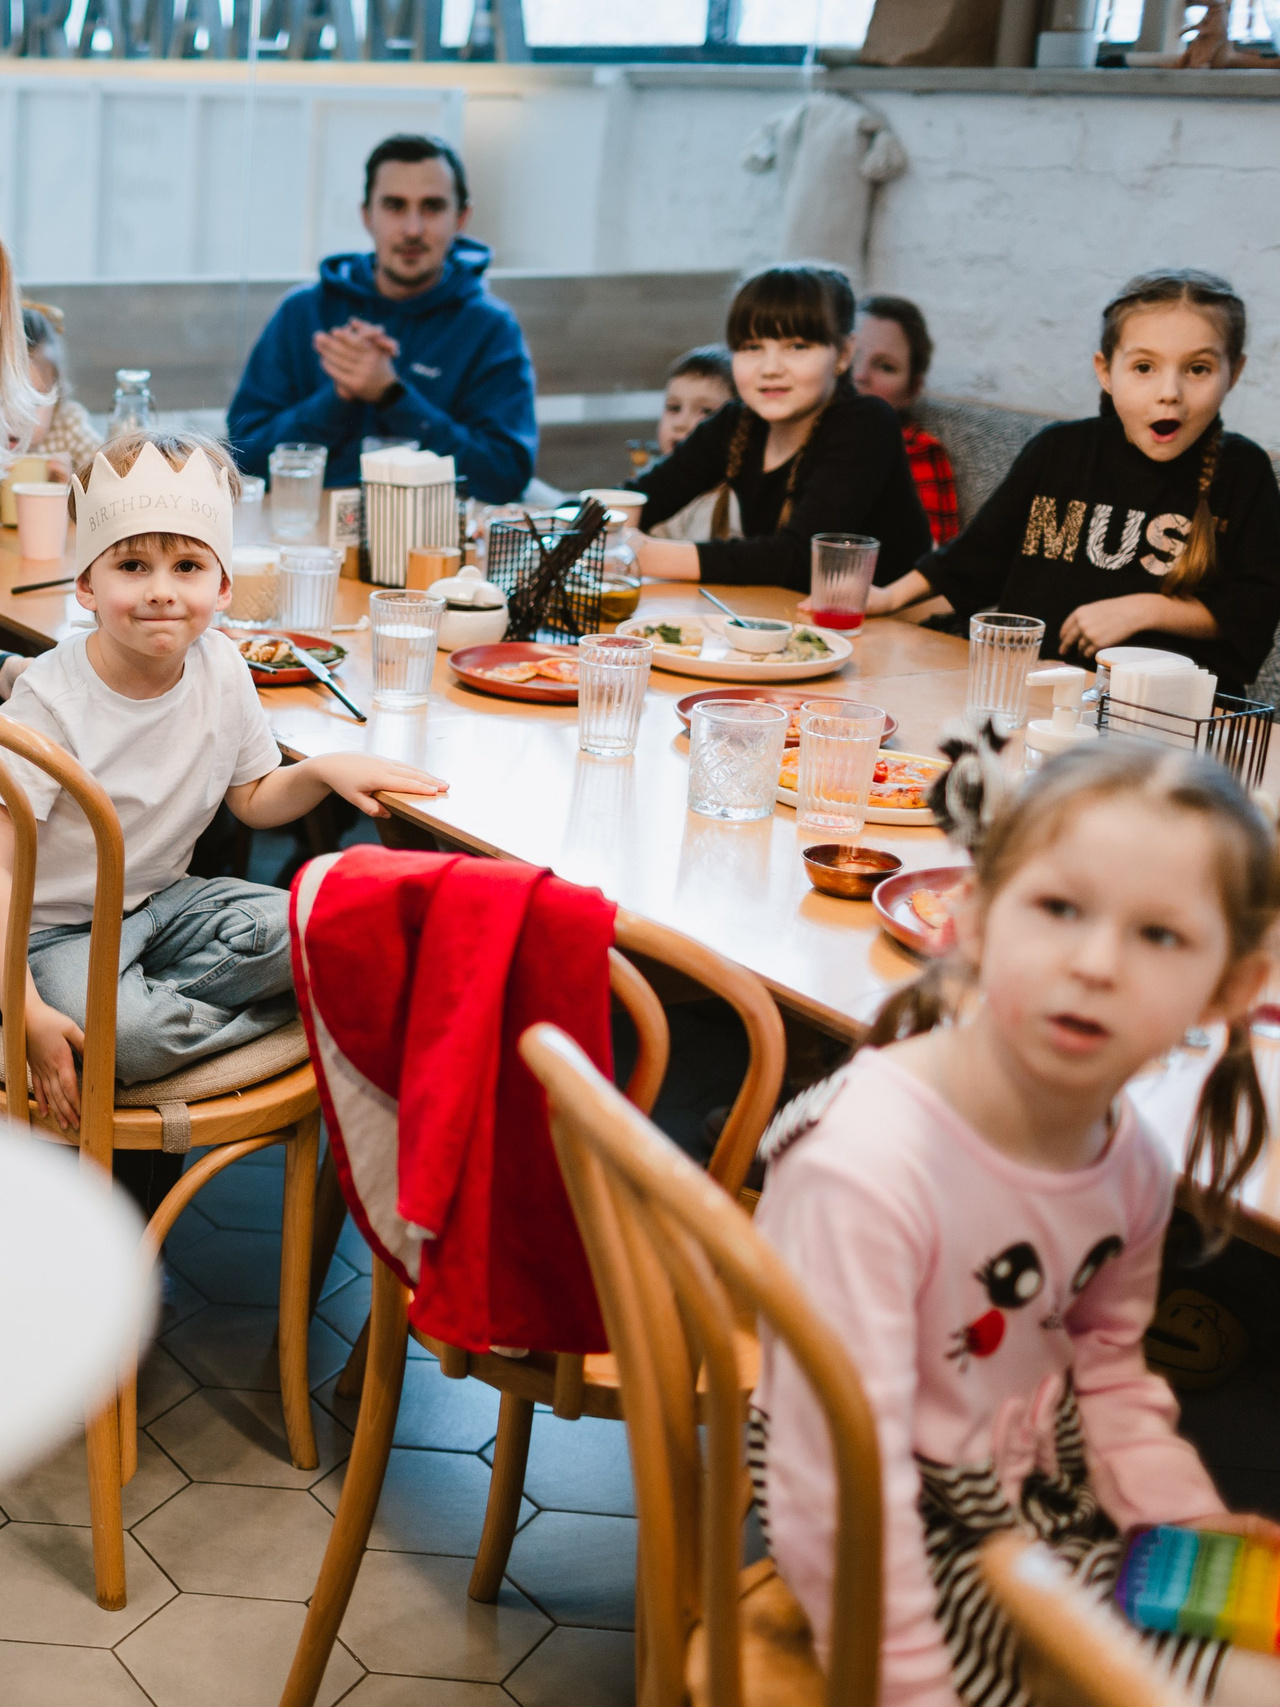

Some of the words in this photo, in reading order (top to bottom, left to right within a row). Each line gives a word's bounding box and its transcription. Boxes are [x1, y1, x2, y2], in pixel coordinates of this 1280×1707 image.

[88, 494, 182, 532] BIRTHDAY
[190, 497, 220, 523] BOY
[1021, 494, 1229, 577] MUS
